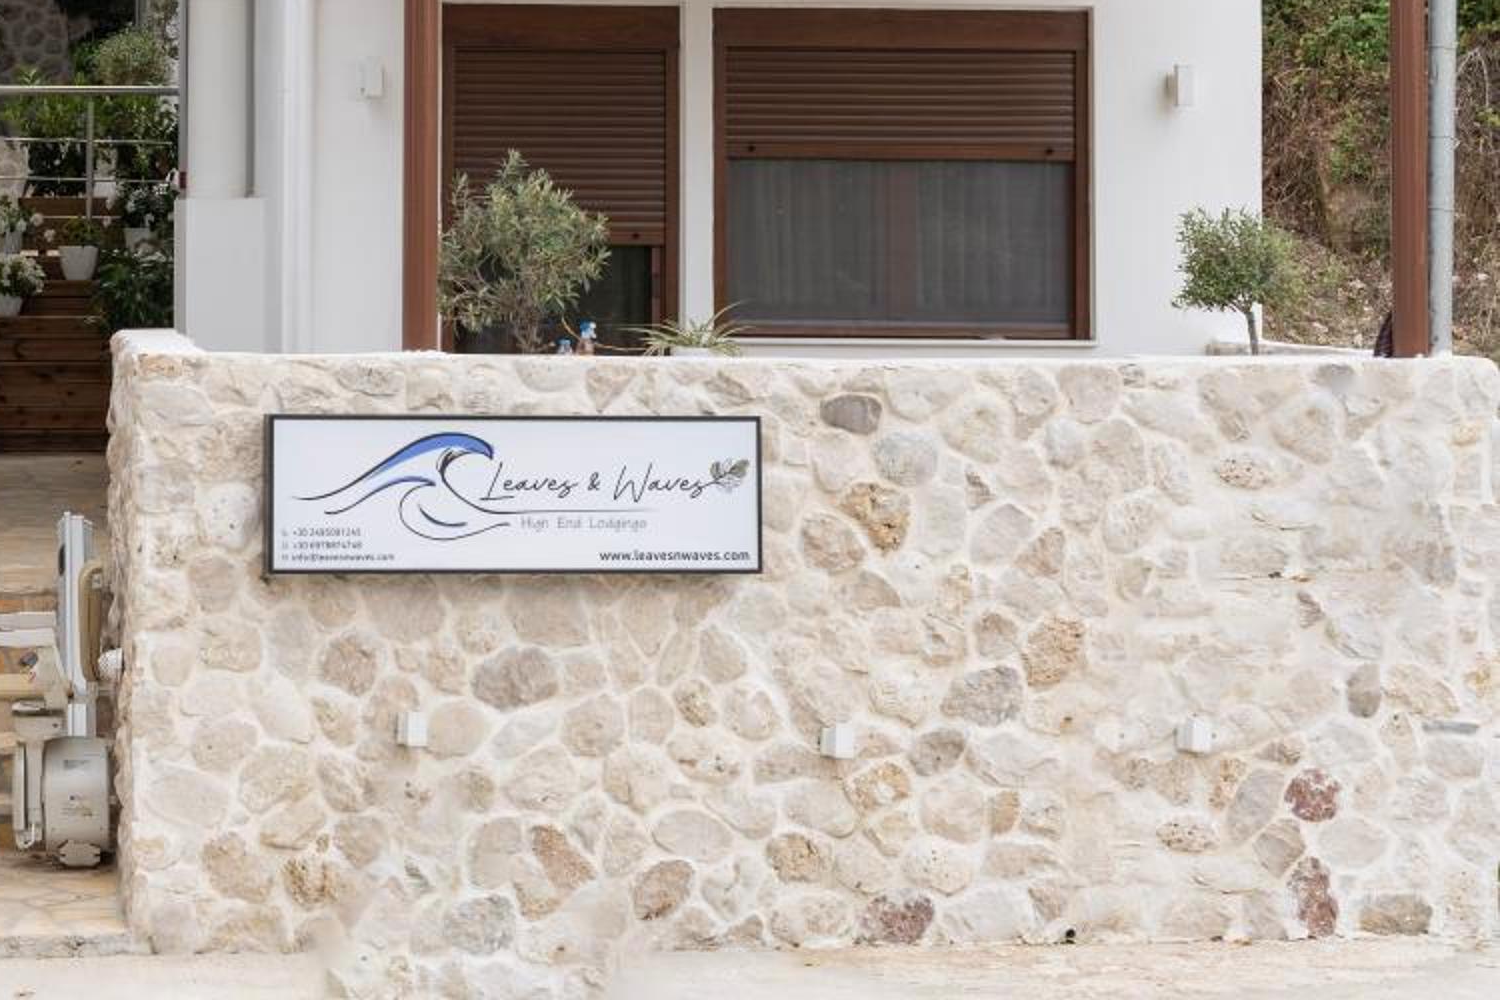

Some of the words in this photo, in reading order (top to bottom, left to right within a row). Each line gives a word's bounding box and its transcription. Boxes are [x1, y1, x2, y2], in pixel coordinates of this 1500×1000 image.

[479, 462, 578, 500] Leaves
[587, 472, 601, 492] &
[613, 461, 707, 503] Waves
[520, 516, 549, 532] High
[557, 516, 581, 529] End
[599, 549, 751, 562] www.leavesnwaves.com
